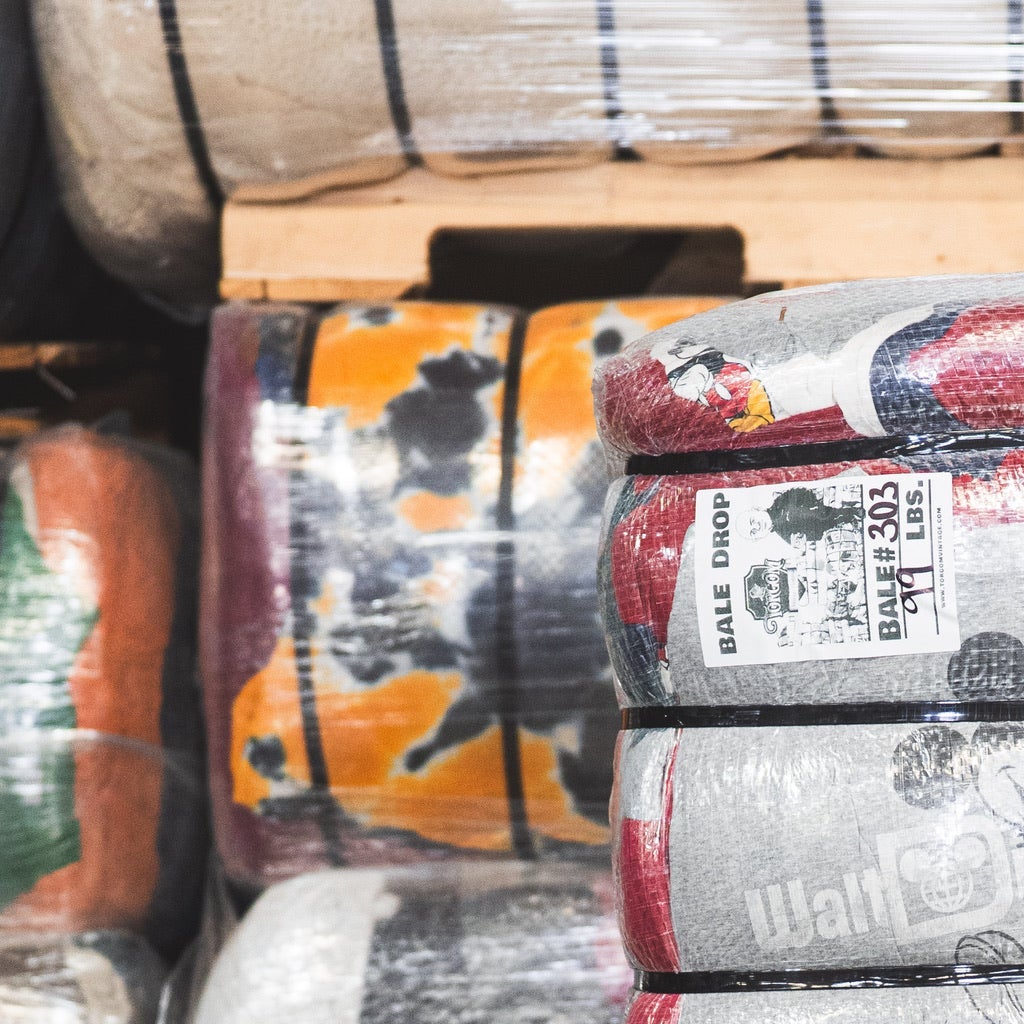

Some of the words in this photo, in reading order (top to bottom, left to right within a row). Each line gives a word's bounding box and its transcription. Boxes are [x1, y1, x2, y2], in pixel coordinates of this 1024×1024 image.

[711, 491, 731, 568] DROP
[868, 481, 899, 543] 303
[905, 480, 926, 541] LBS.
[712, 583, 738, 655] BALE
[895, 565, 934, 615] 99
[744, 867, 892, 951] Walt
